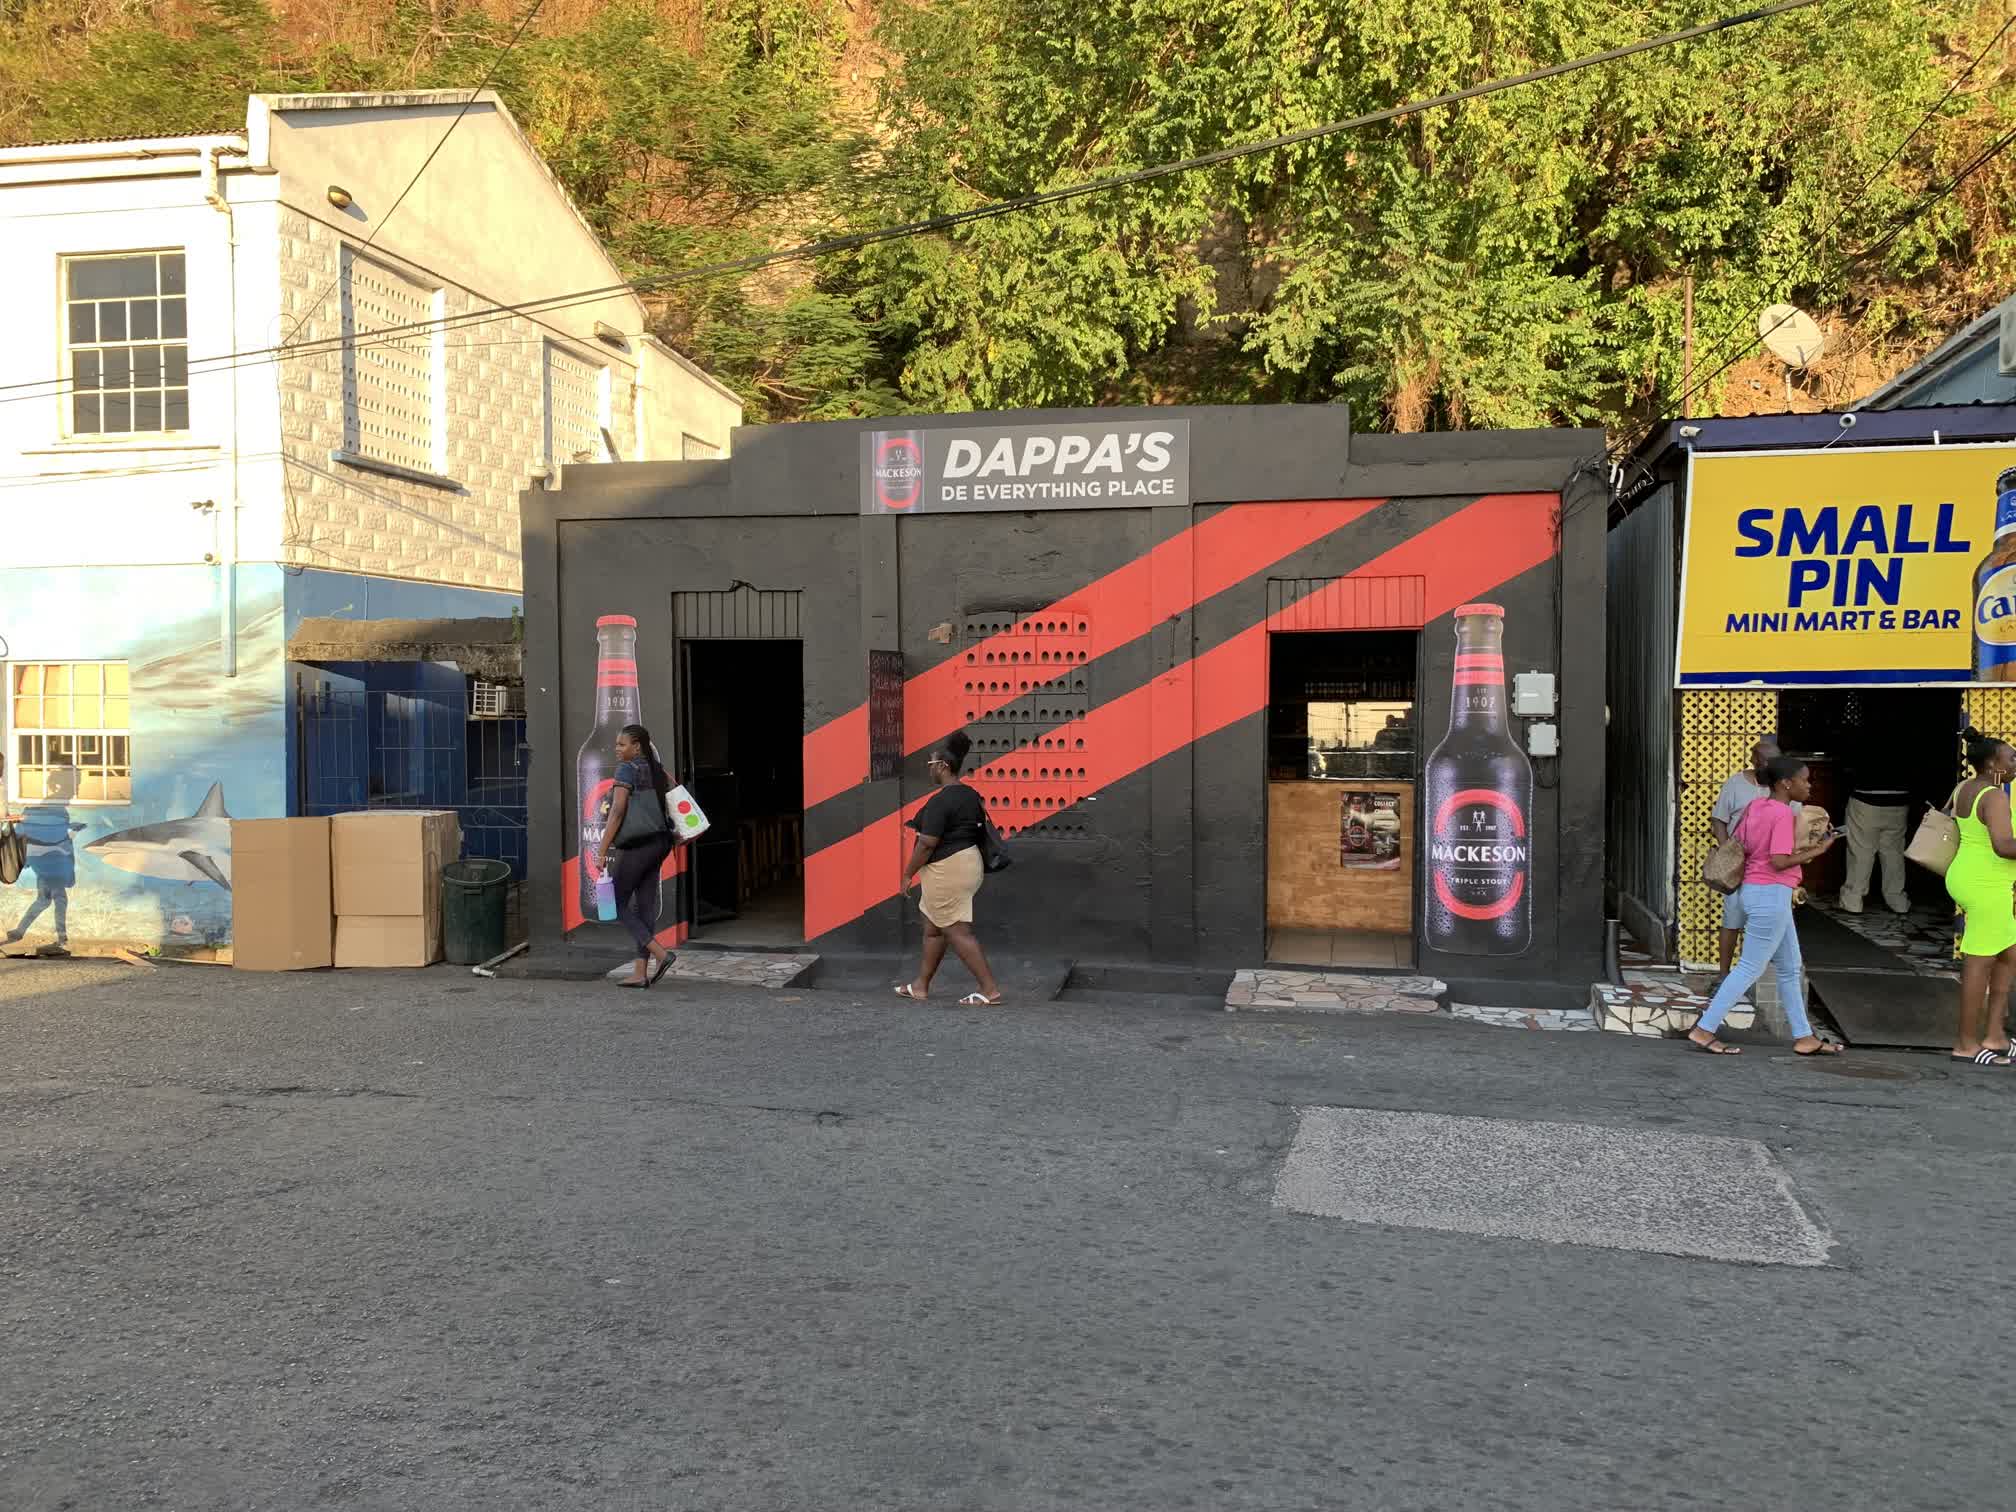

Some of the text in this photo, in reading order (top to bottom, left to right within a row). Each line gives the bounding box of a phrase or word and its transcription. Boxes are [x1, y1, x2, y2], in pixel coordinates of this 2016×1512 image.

[942, 432, 1175, 479] DAPPA'S
[942, 479, 1175, 501] DE EVERYTHING PLACE
[1735, 503, 1971, 558] SMALL
[1787, 557, 1904, 608] PIN
[1725, 608, 1961, 633] MINI MART & BAR
[1432, 844, 1526, 862] MACKESON
